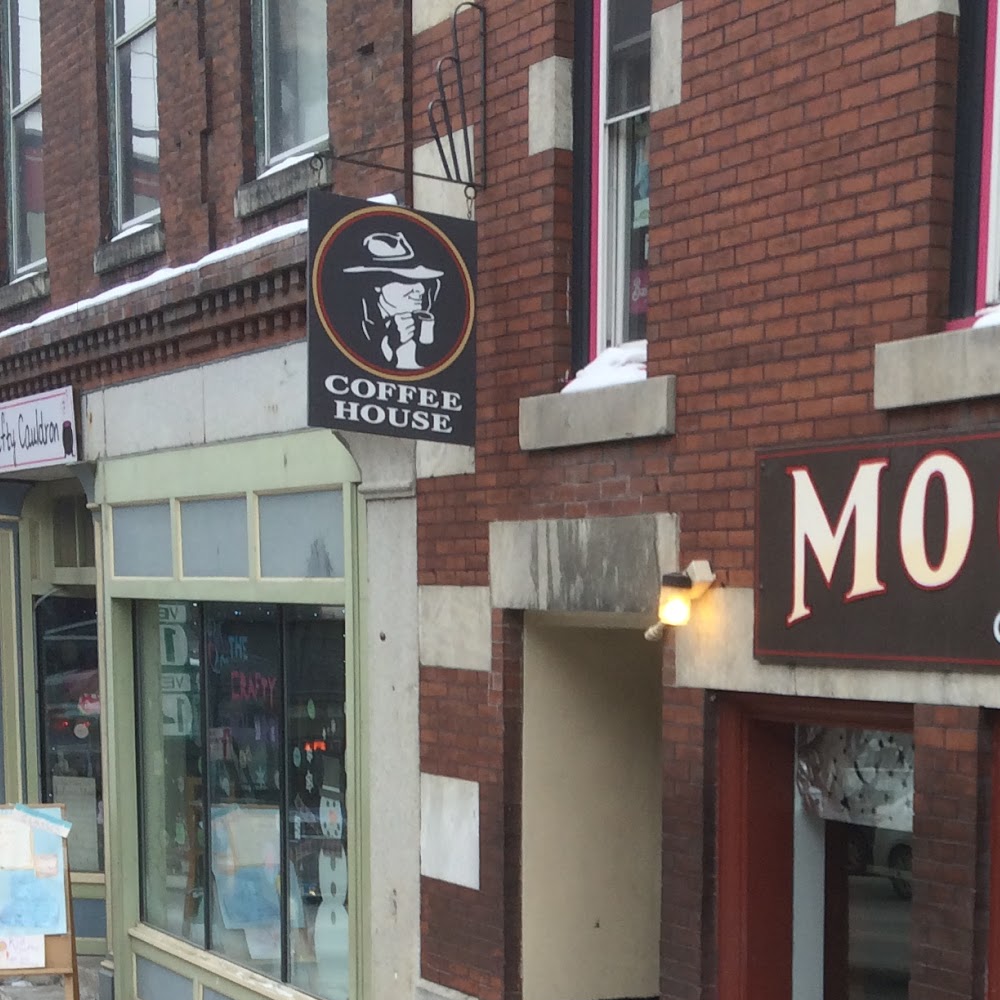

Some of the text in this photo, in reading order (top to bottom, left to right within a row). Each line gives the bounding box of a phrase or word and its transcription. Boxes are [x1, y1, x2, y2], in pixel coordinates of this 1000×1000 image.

[324, 374, 463, 411] COFFEE
[18, 408, 60, 450] Cauldron
[333, 399, 453, 434] HOUSE
